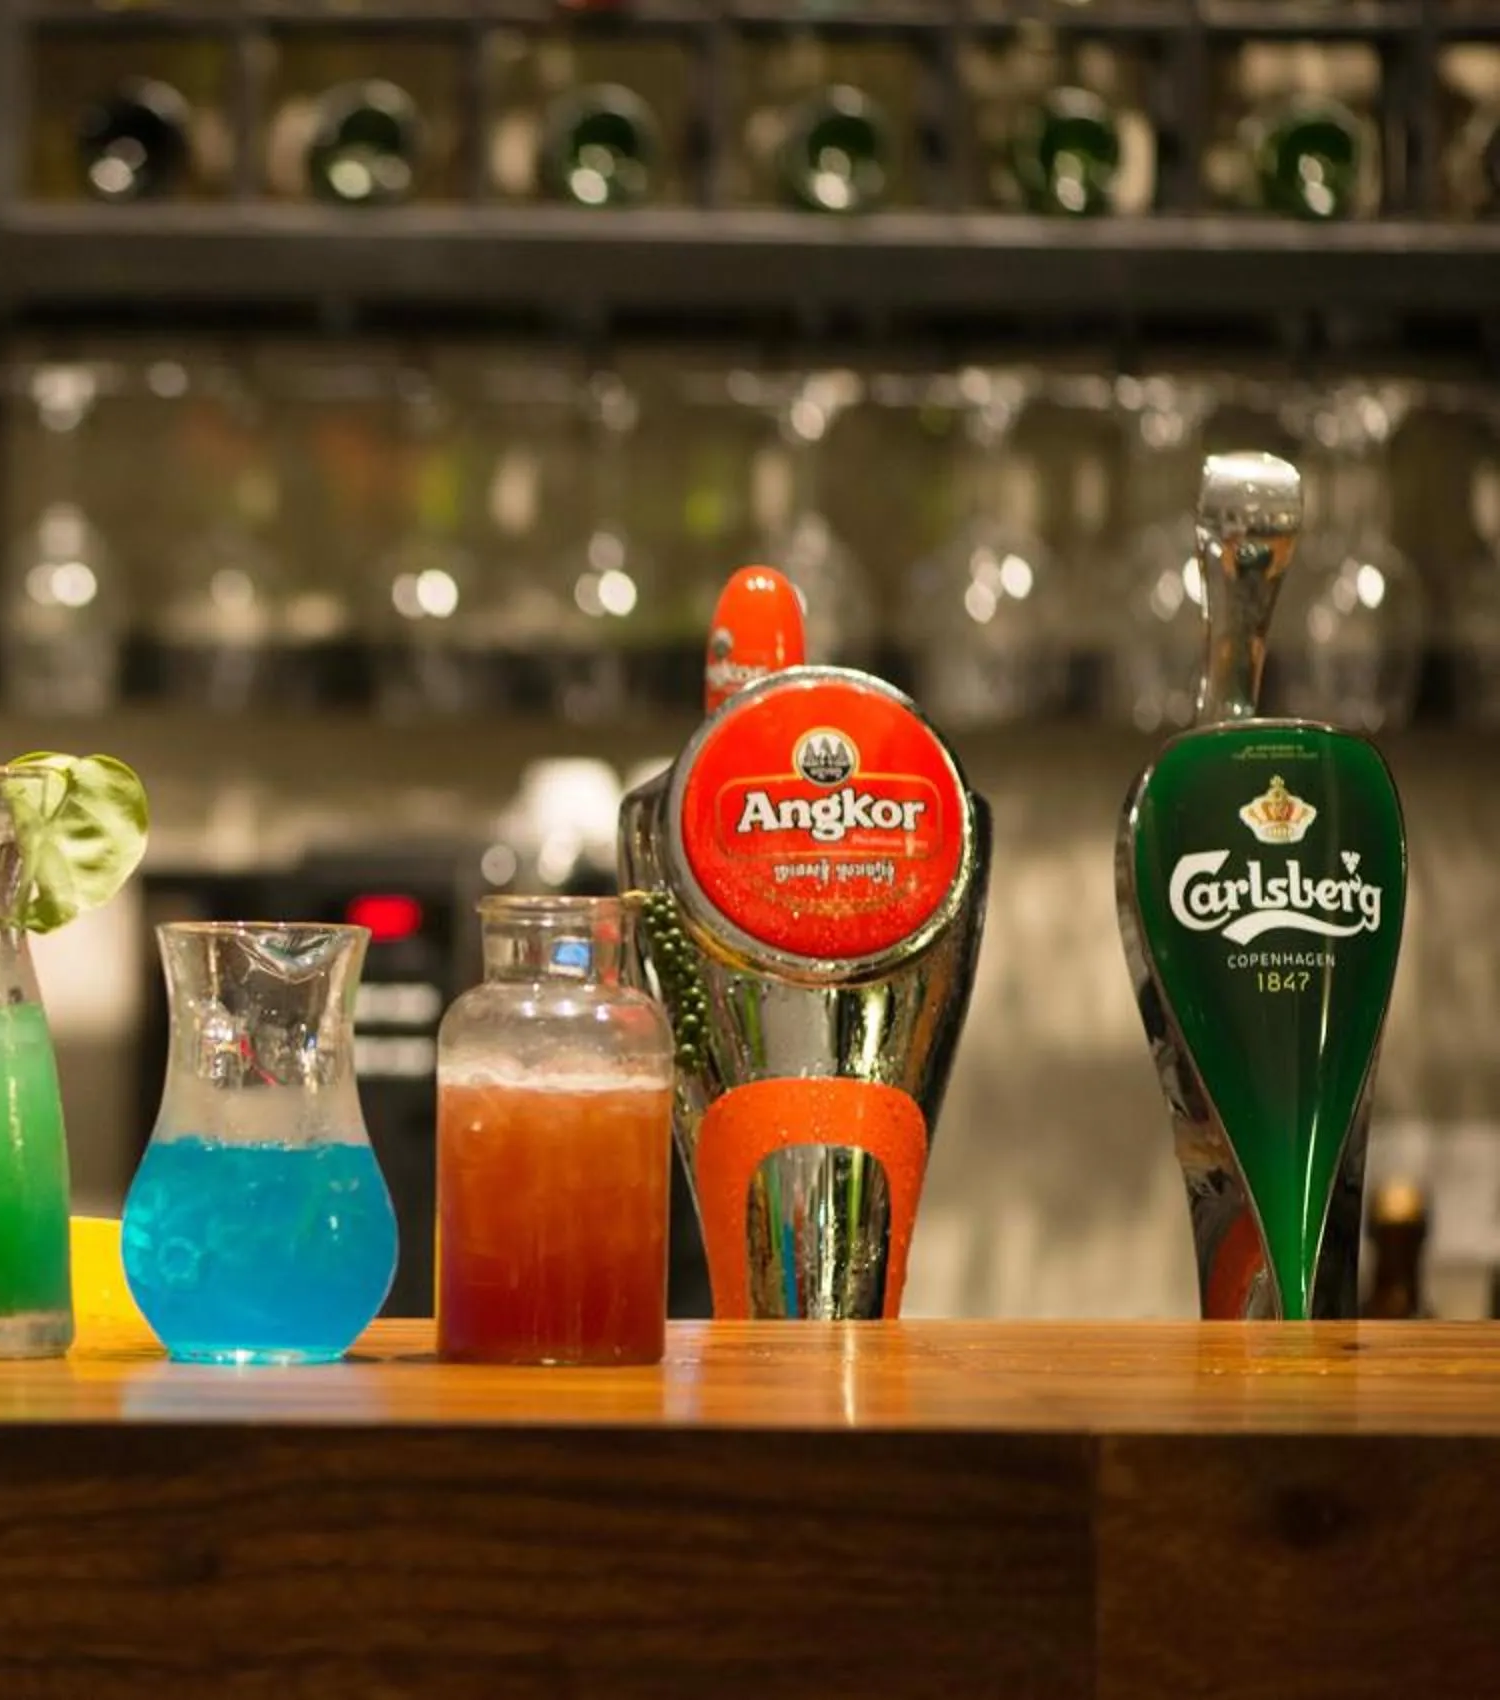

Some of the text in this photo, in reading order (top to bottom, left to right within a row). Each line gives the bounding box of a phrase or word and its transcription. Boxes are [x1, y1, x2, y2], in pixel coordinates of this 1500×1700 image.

[736, 787, 926, 842] Angkor
[1168, 849, 1383, 946] Carlsberg
[1227, 952, 1337, 969] COPENHAGEN
[1256, 971, 1312, 993] 1847
